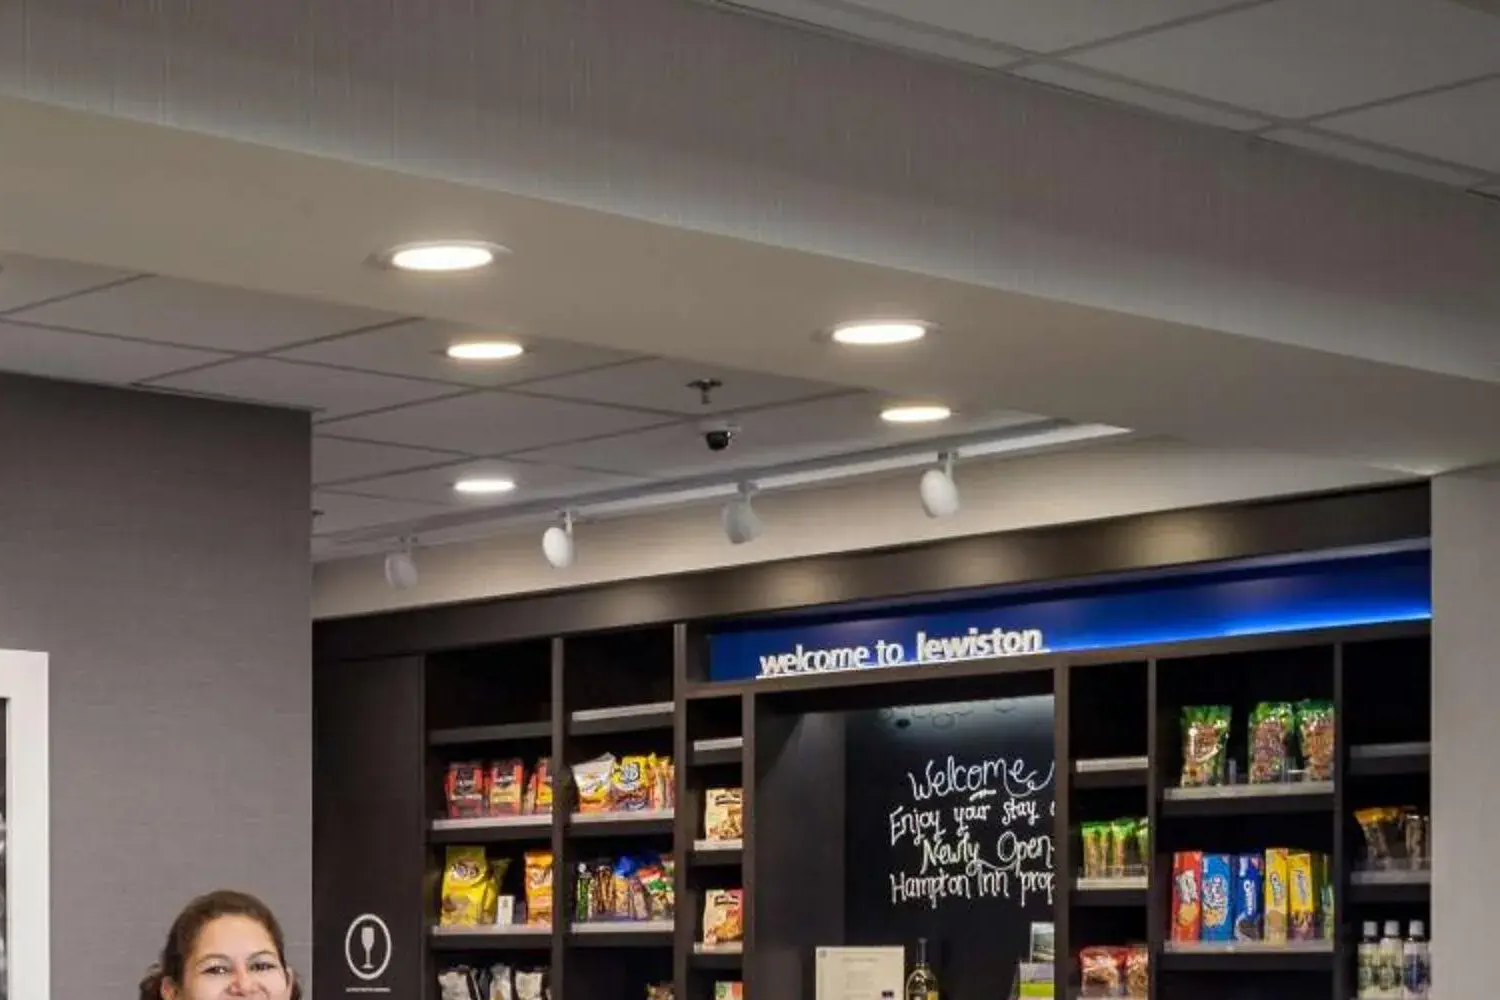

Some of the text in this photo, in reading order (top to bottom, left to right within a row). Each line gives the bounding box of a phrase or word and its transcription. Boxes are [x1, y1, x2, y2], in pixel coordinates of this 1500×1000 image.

[759, 627, 1043, 676] welcome to lewiston
[907, 755, 1040, 801] Welcome
[889, 805, 947, 847] Enjoy
[953, 804, 992, 837] your
[1001, 797, 1040, 826] stay
[920, 832, 981, 875] Newly
[889, 868, 971, 909] Hampton
[976, 863, 1009, 898] Inn
